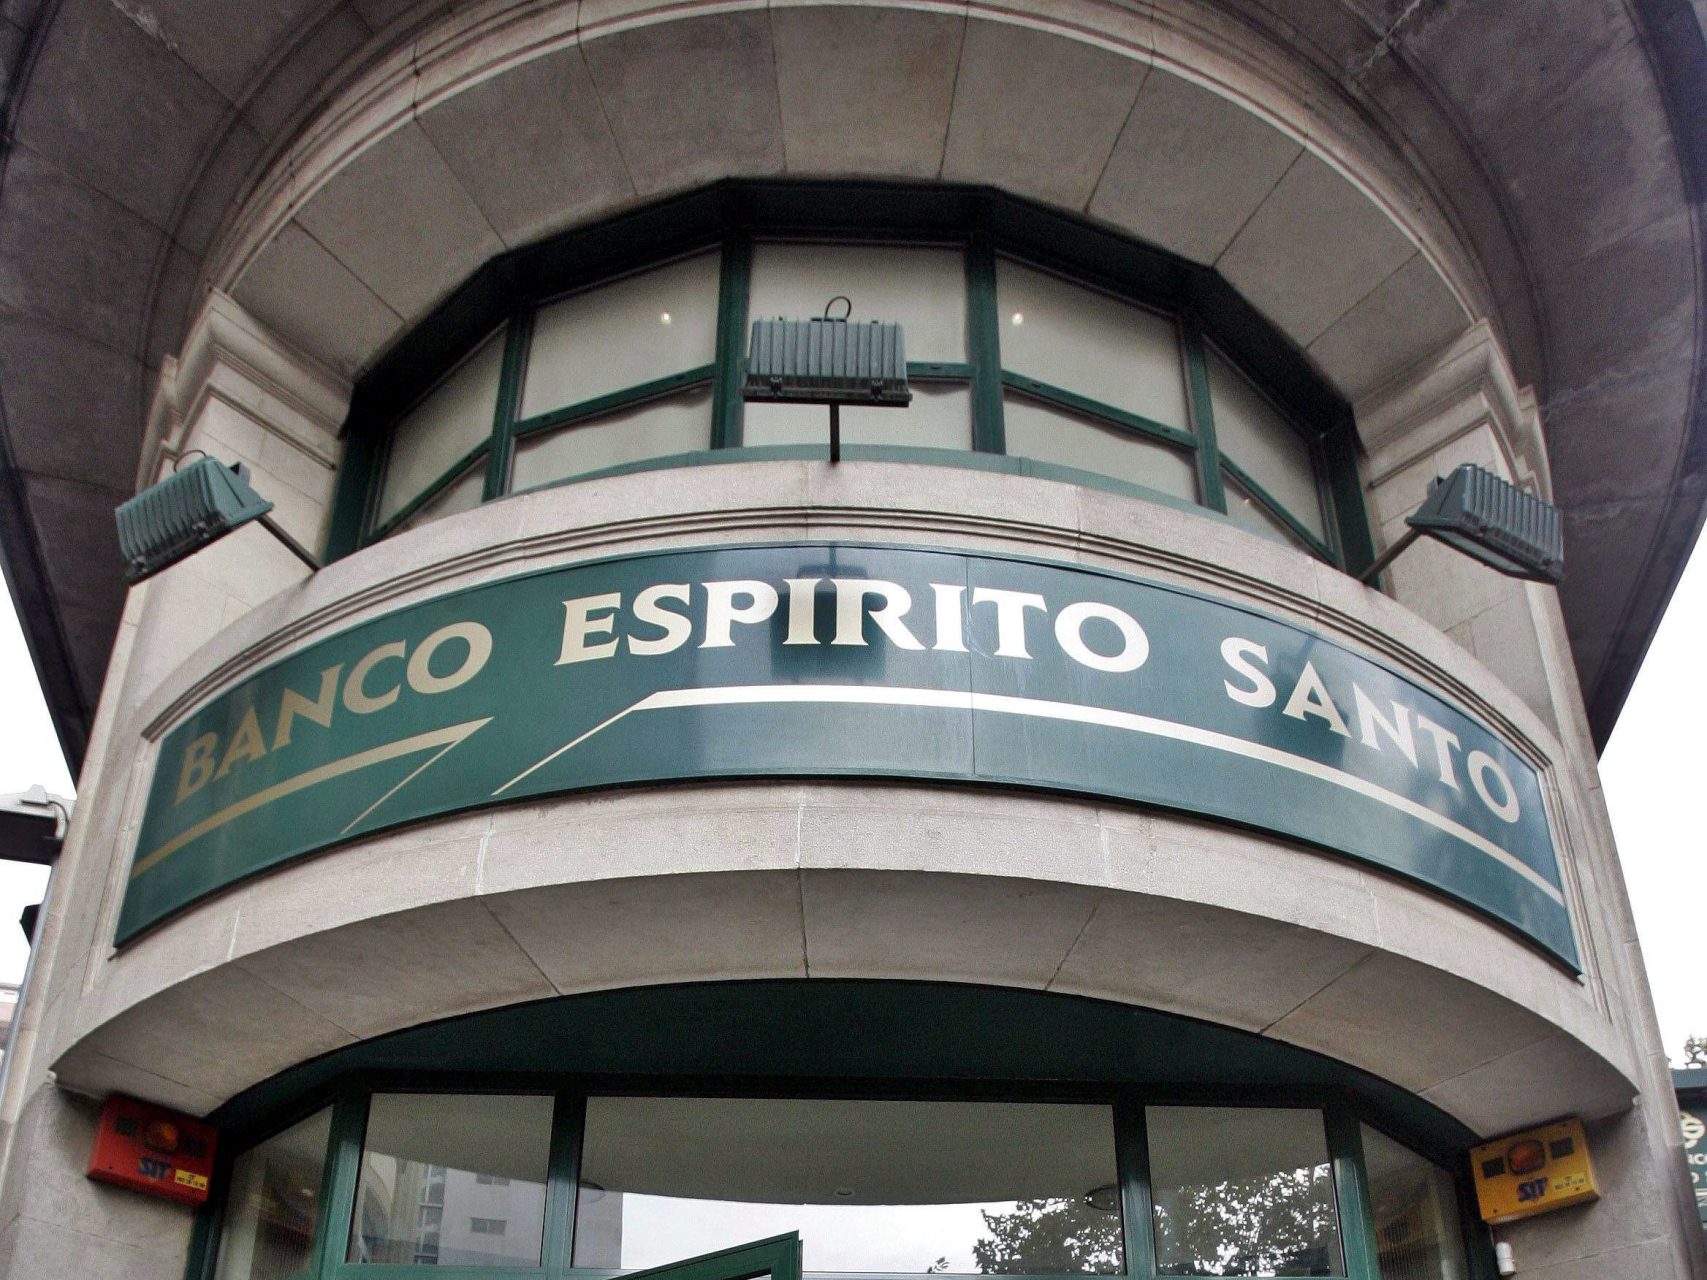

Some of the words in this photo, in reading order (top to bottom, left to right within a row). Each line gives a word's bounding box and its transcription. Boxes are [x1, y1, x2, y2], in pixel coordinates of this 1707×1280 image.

[174, 621, 493, 804] BANCO
[554, 577, 1150, 673] ESPIRITO
[1220, 636, 1520, 824] SANTO
